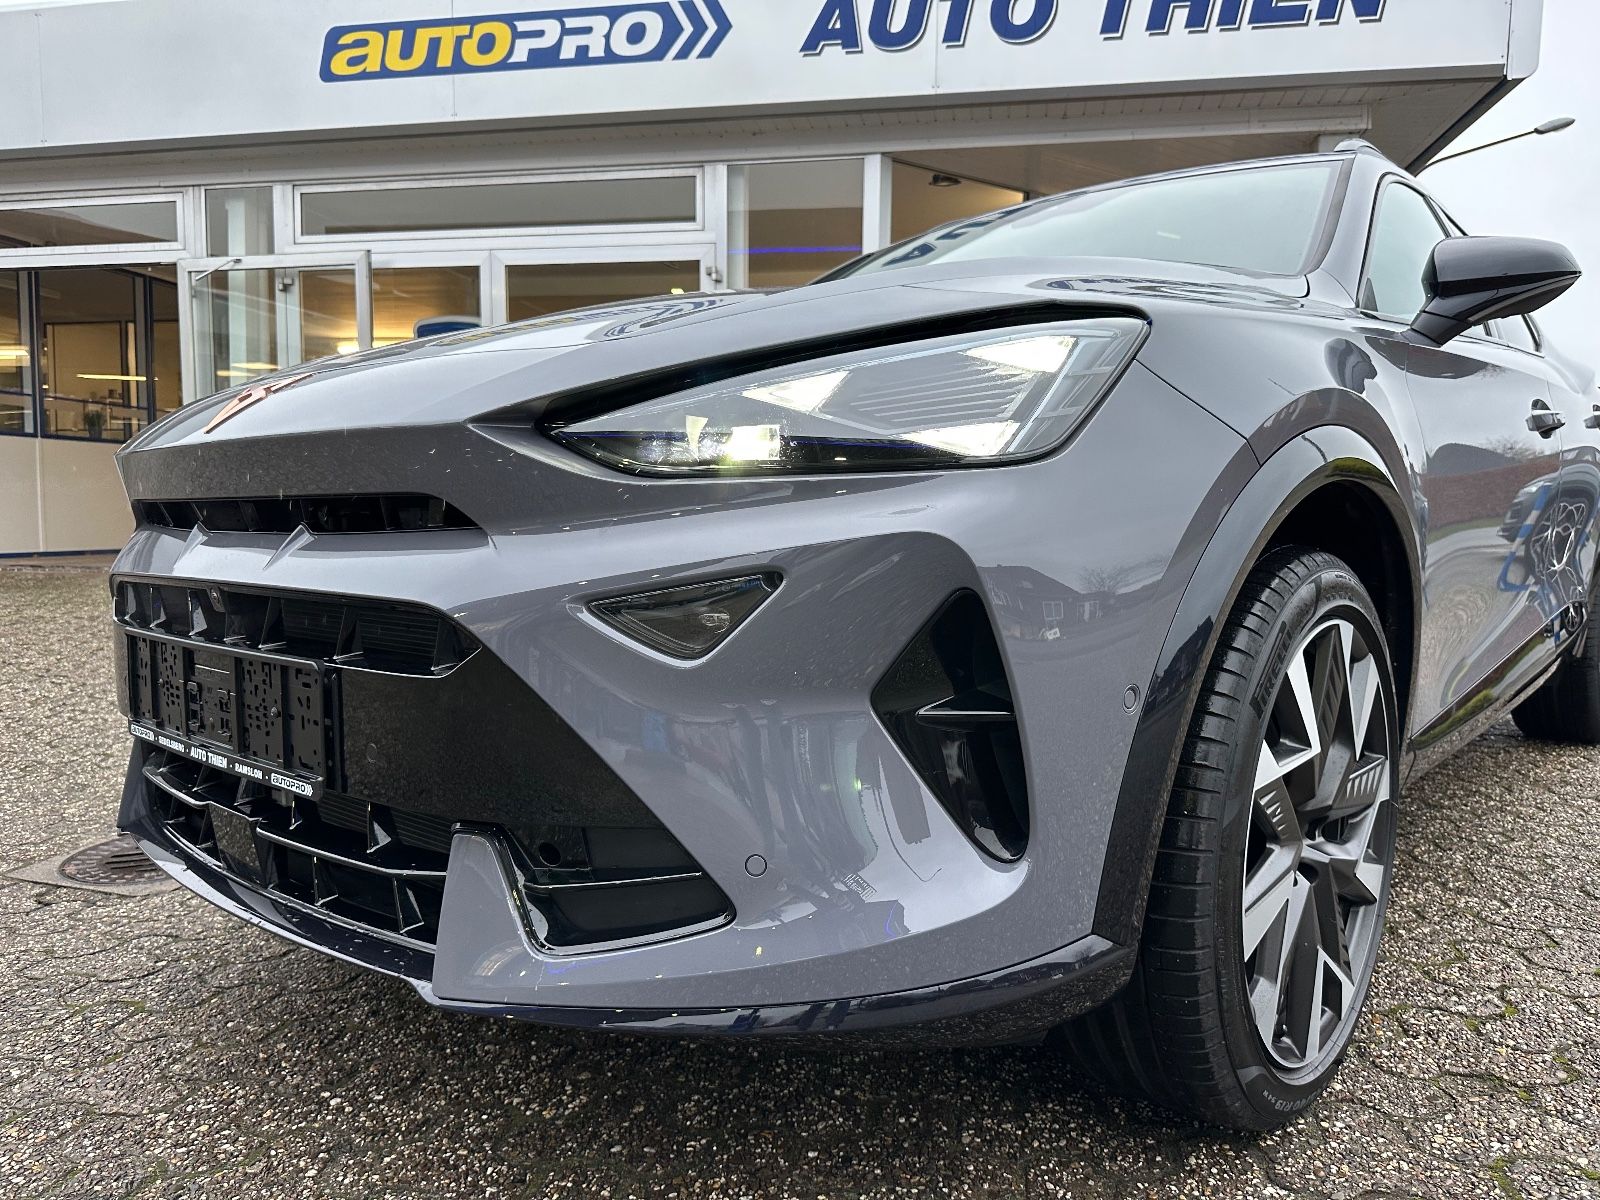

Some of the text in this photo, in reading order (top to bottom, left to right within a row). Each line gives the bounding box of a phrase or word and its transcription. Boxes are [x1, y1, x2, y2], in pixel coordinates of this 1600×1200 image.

[799, 0, 1058, 56] AUTO
[190, 746, 207, 761] AUTO
[208, 752, 228, 769] THIEN
